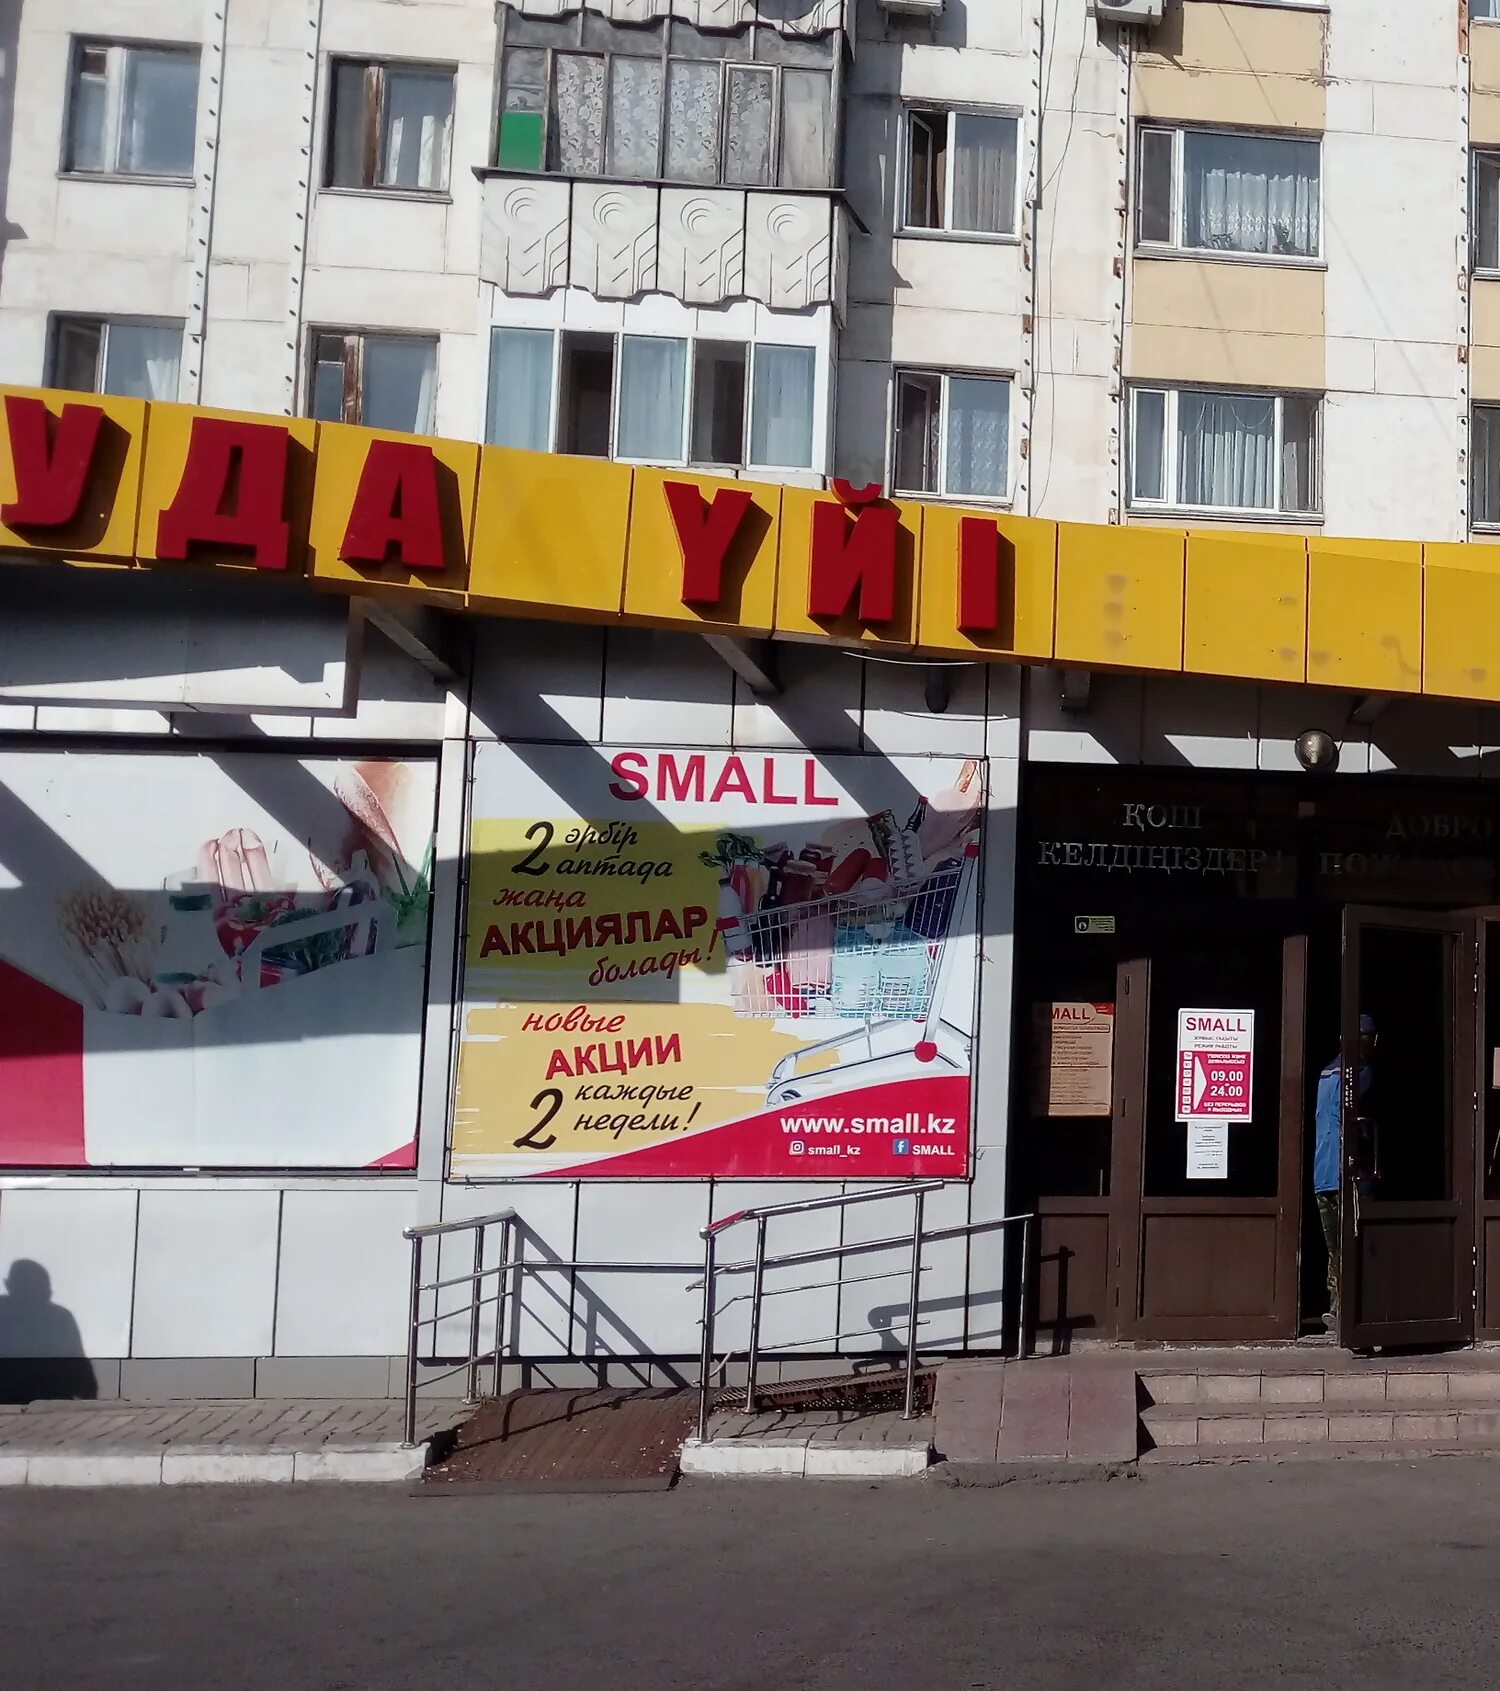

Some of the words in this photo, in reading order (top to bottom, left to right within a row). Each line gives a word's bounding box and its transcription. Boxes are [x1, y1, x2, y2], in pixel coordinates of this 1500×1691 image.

[0, 395, 445, 569] УДА
[608, 752, 839, 805] SMALL
[511, 821, 554, 877] 2
[565, 821, 638, 852] әрбір
[555, 855, 673, 884] аптада
[493, 888, 587, 913] жаңа
[479, 905, 708, 958] АКЦИЯЛАР
[588, 929, 718, 986] болады!
[521, 1005, 626, 1033] новые
[1052, 1008, 1091, 1020] MALL
[1186, 1017, 1247, 1032] SMALL
[545, 1033, 682, 1080] АКЦИИ
[1210, 1071, 1243, 1082] 09.00
[1210, 1086, 1243, 1097] 24.00
[513, 1088, 564, 1149] 2
[574, 1084, 694, 1109] каждые
[573, 1101, 702, 1140] недели!
[780, 1113, 956, 1134] www.small.kz
[808, 1145, 861, 1158] small_kz
[912, 1145, 955, 1155] SMALL
